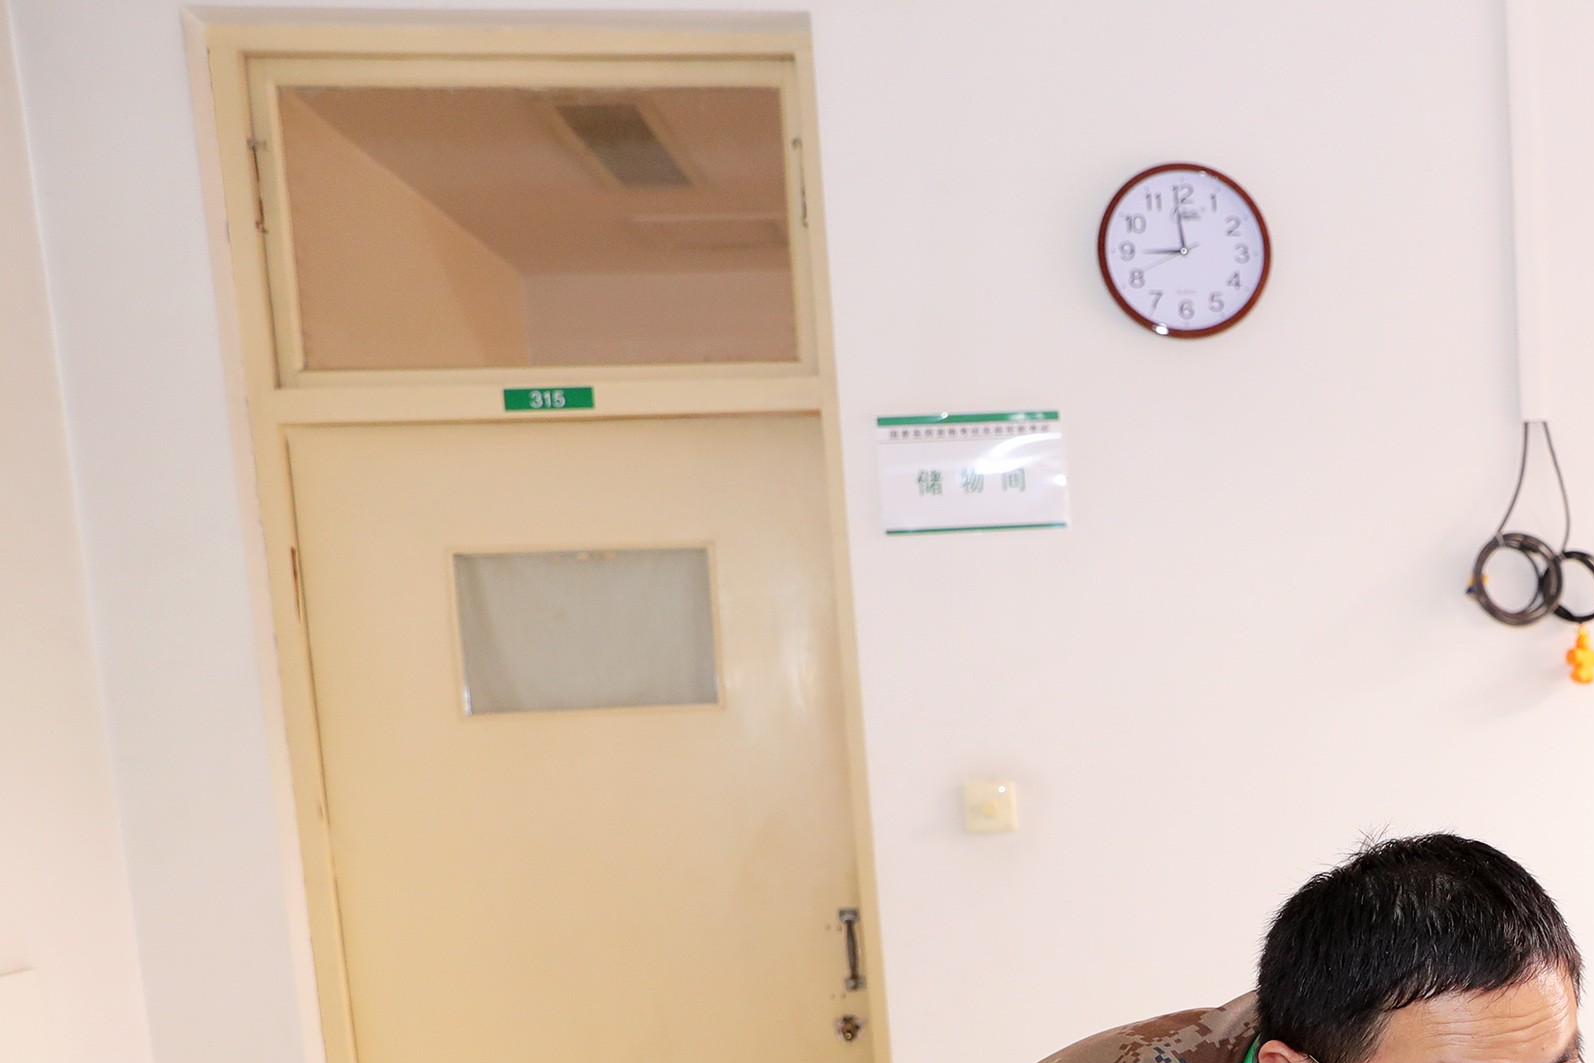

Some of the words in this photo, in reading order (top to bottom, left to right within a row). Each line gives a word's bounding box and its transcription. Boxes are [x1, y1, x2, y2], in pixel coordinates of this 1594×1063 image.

[1146, 193, 1162, 212] 11
[1172, 184, 1194, 204] 12
[1210, 193, 1218, 212] 1
[1126, 213, 1147, 234] 10
[1226, 215, 1241, 236] 2
[1119, 241, 1136, 261] 9
[1234, 243, 1250, 264] 3
[1129, 268, 1146, 289] 8
[1226, 271, 1241, 289] 4
[1150, 290, 1163, 311] 7
[1178, 299, 1195, 320] 6
[1209, 292, 1225, 312] 5
[529, 389, 566, 409] 315
[917, 467, 1026, 497] 储物间
